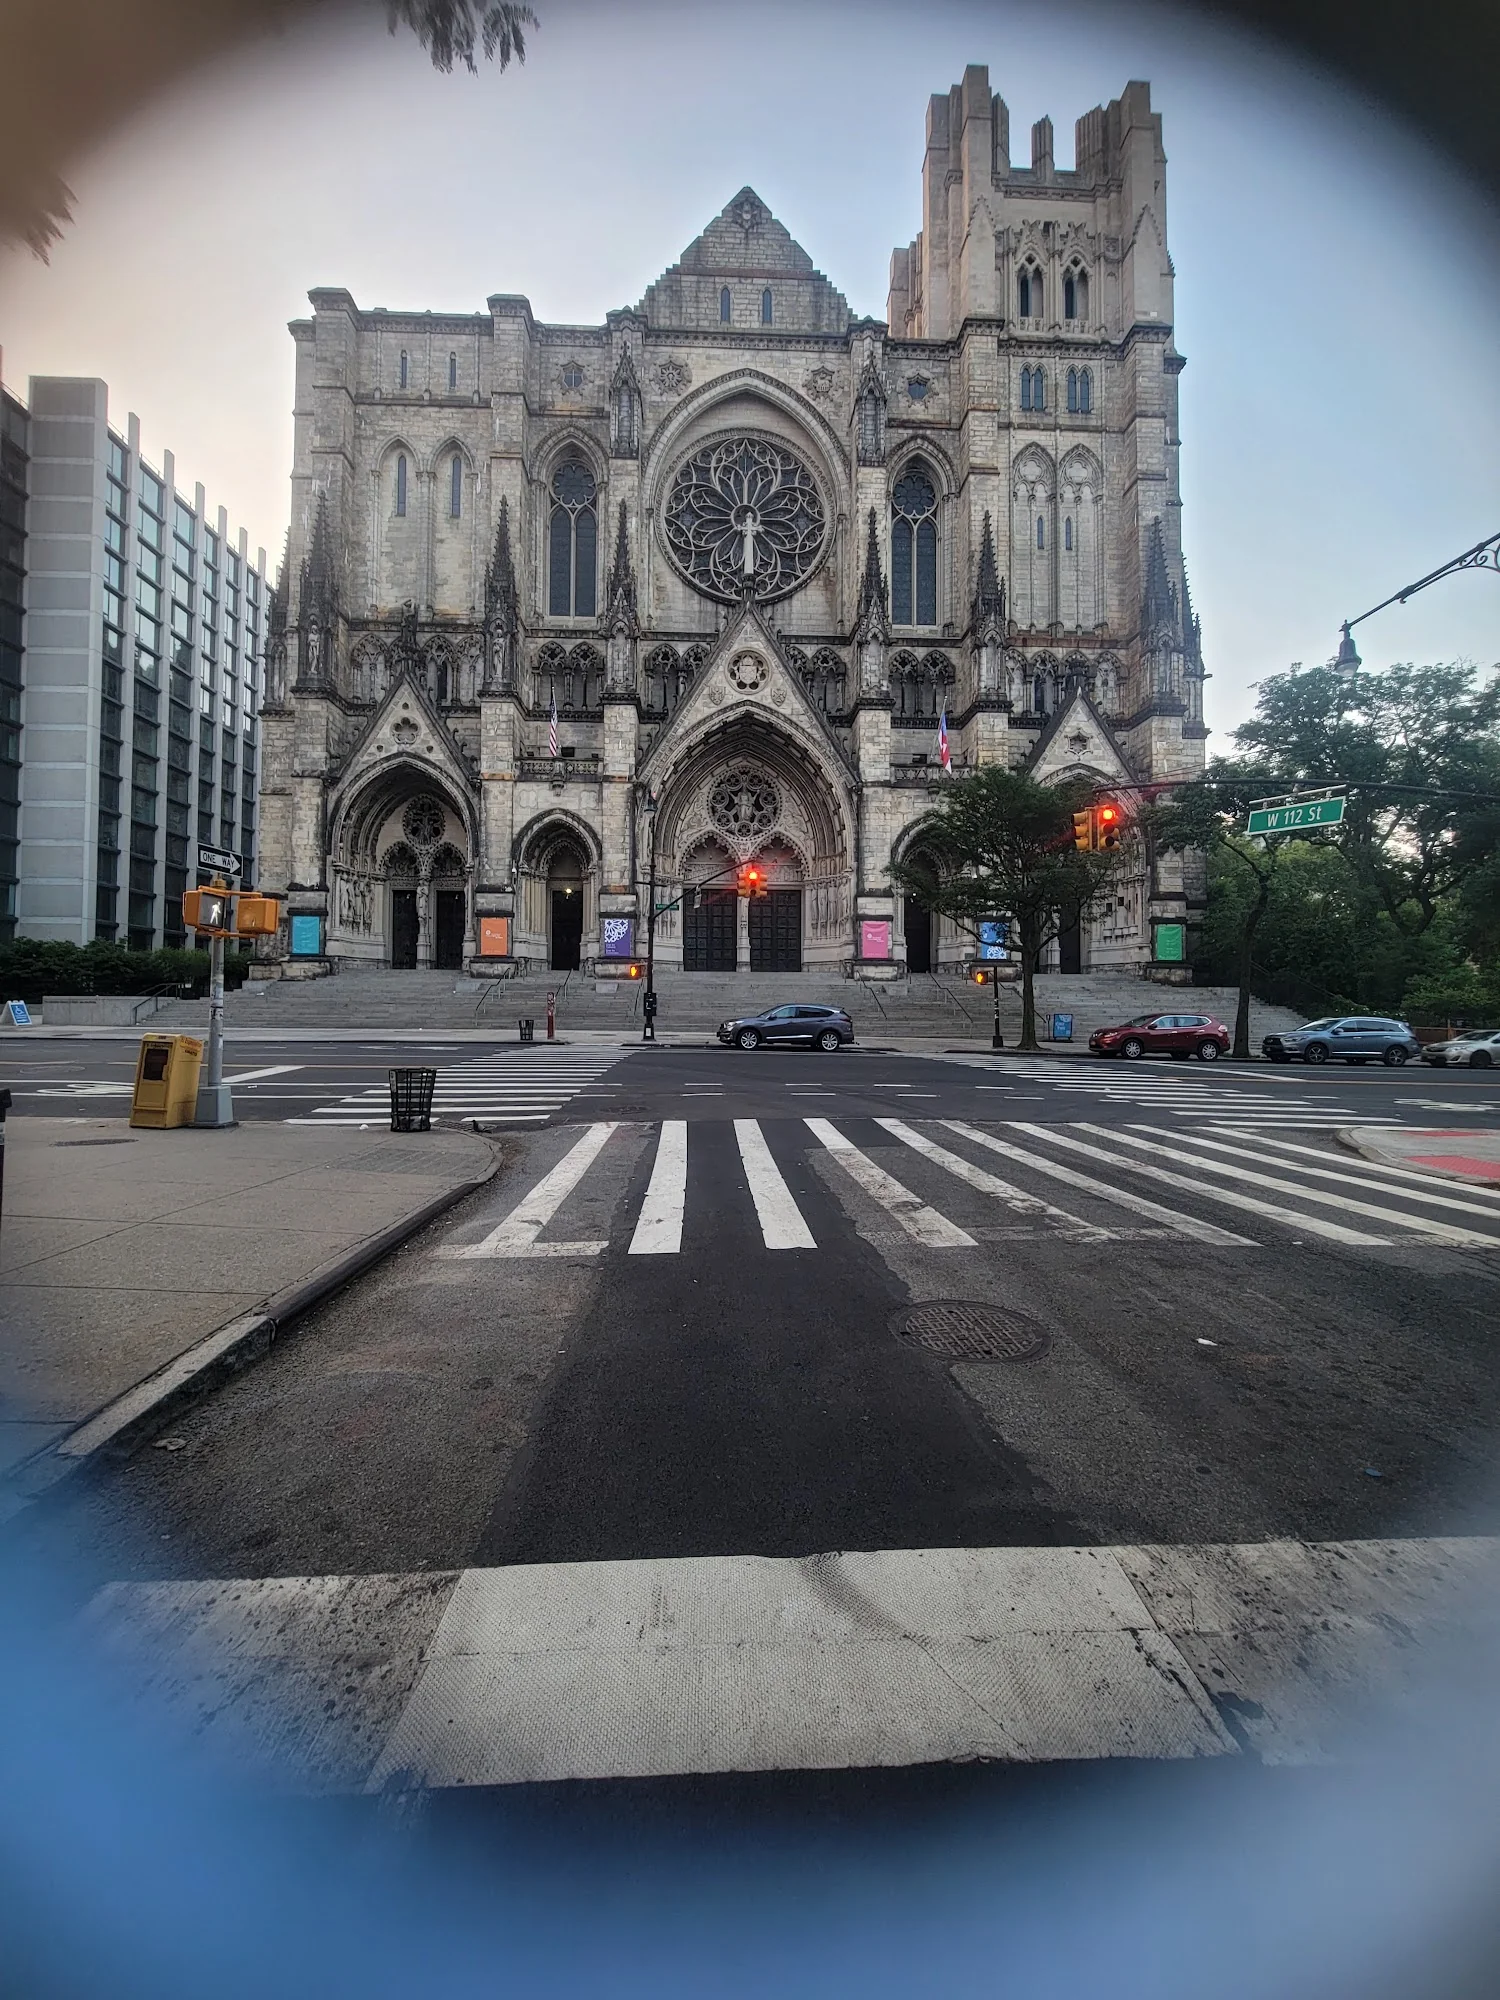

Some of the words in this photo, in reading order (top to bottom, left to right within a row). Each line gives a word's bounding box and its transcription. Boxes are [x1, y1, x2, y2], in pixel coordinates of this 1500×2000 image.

[1267, 812, 1279, 827] W
[1284, 809, 1303, 825] 112
[1308, 806, 1322, 821] St
[203, 852, 216, 864] ONE
[222, 856, 235, 869] WAY
